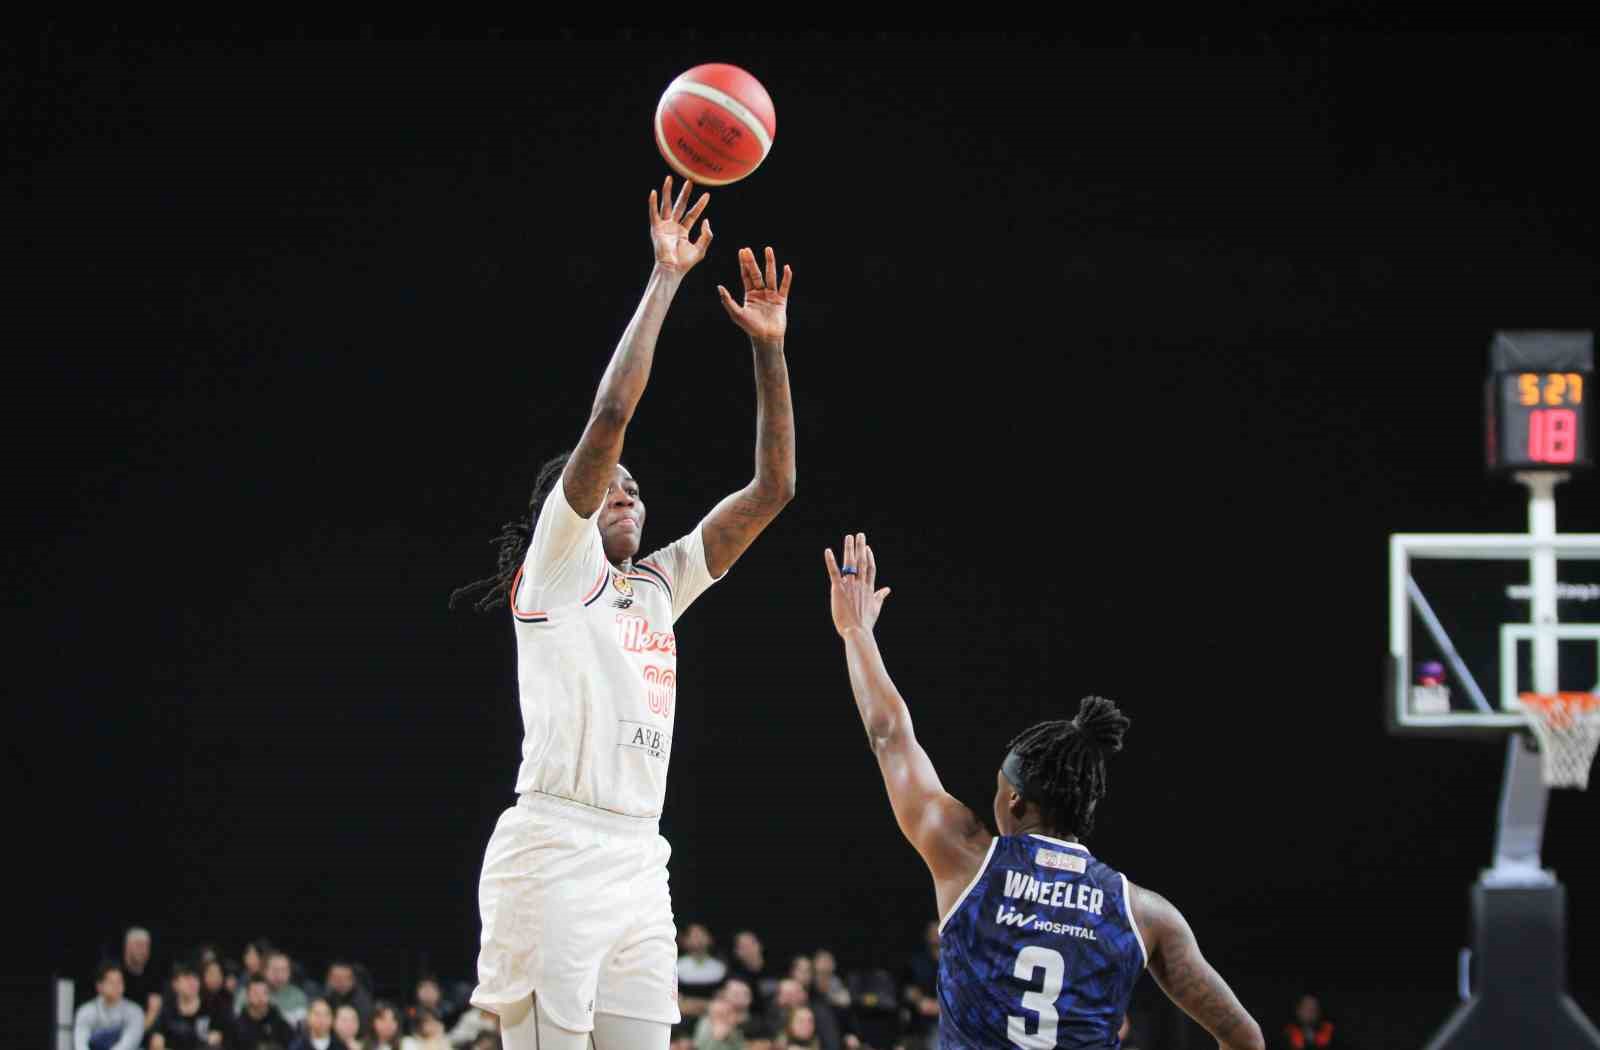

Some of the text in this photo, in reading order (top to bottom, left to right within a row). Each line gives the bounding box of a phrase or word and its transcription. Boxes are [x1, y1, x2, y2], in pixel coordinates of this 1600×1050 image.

[1528, 408, 1577, 463] 18
[1004, 870, 1104, 915] WHEELER
[1034, 920, 1097, 941] HOSPITAL
[1007, 945, 1064, 1050] 3
